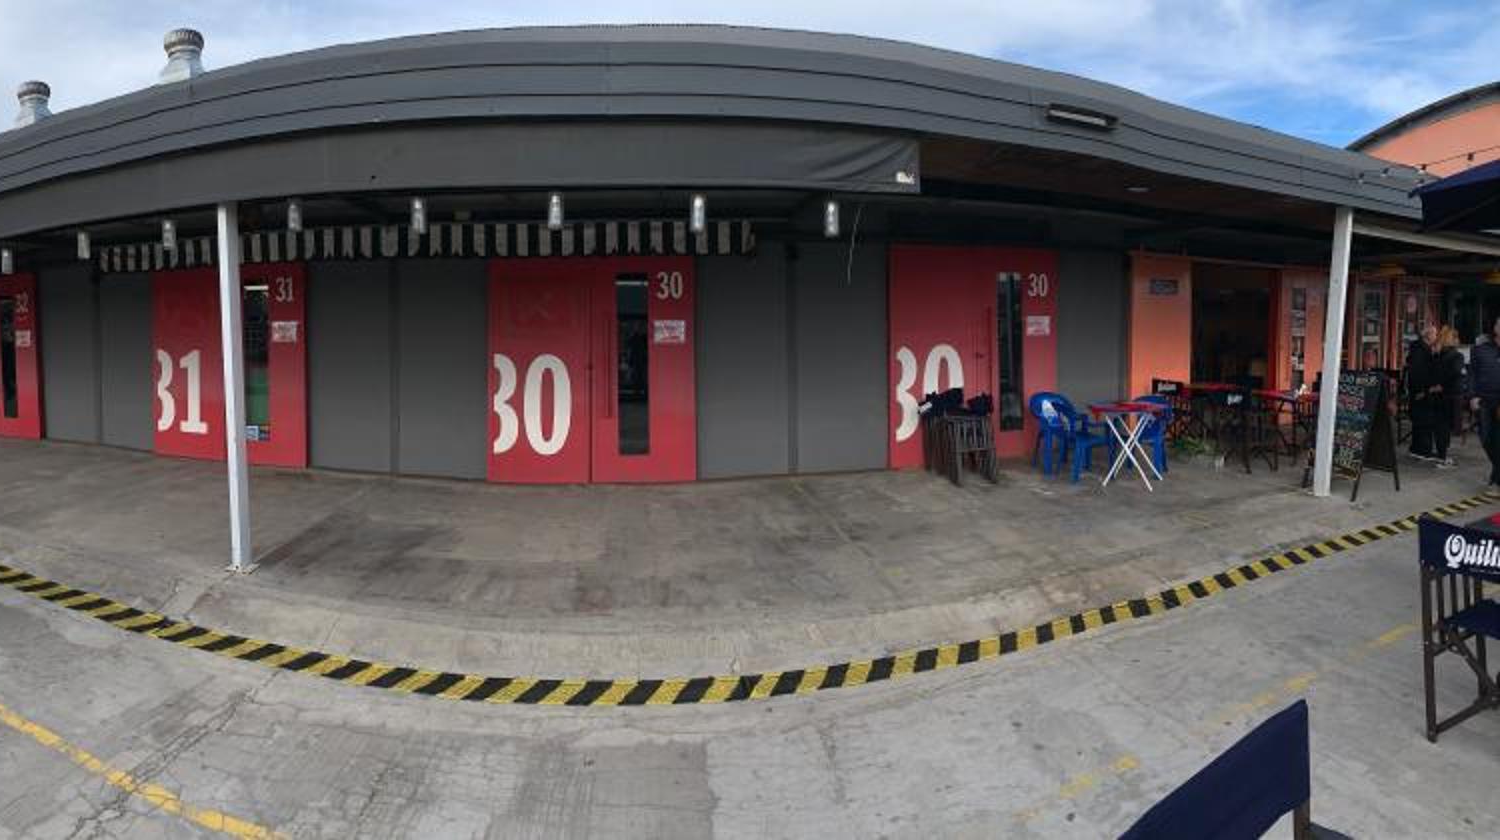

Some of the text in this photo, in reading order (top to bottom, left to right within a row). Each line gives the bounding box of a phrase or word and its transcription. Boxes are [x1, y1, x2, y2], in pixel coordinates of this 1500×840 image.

[275, 276, 294, 302] 31
[656, 271, 683, 300] 30
[1027, 272, 1049, 297] 30
[156, 349, 208, 434] 31
[493, 353, 572, 456] 30
